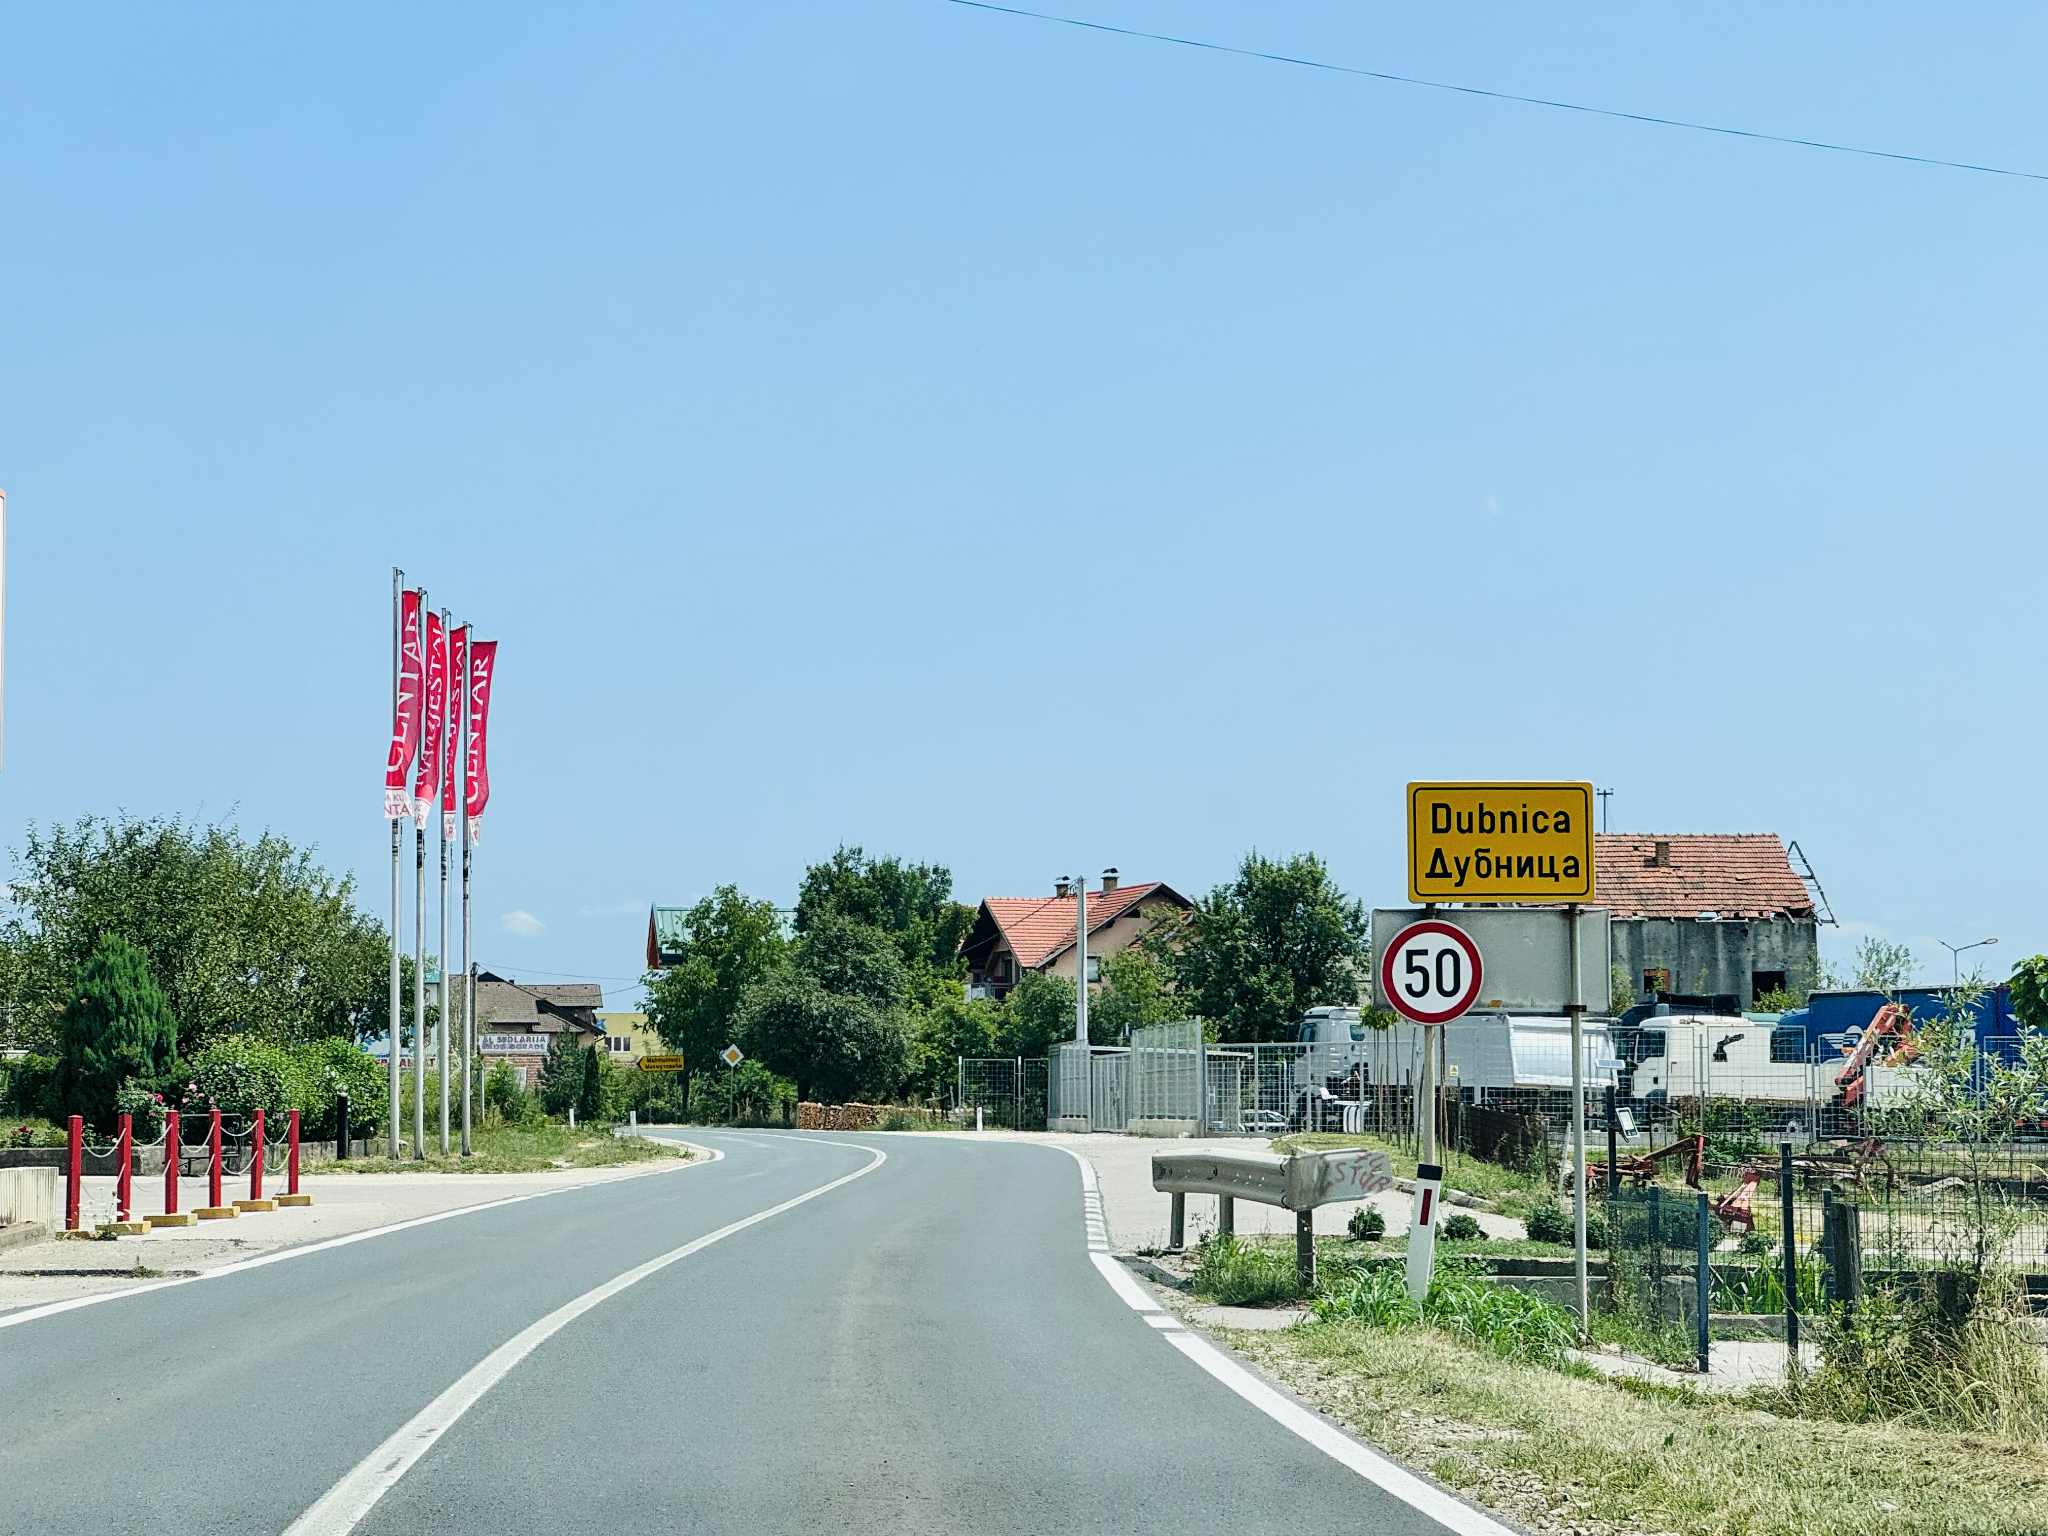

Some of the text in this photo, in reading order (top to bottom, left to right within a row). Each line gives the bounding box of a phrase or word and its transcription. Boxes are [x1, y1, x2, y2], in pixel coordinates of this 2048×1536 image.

[466, 655, 489, 805] CENTAR
[1431, 802, 1571, 834] Dubnica
[1425, 847, 1580, 887] Дубница
[1405, 948, 1460, 998] 50
